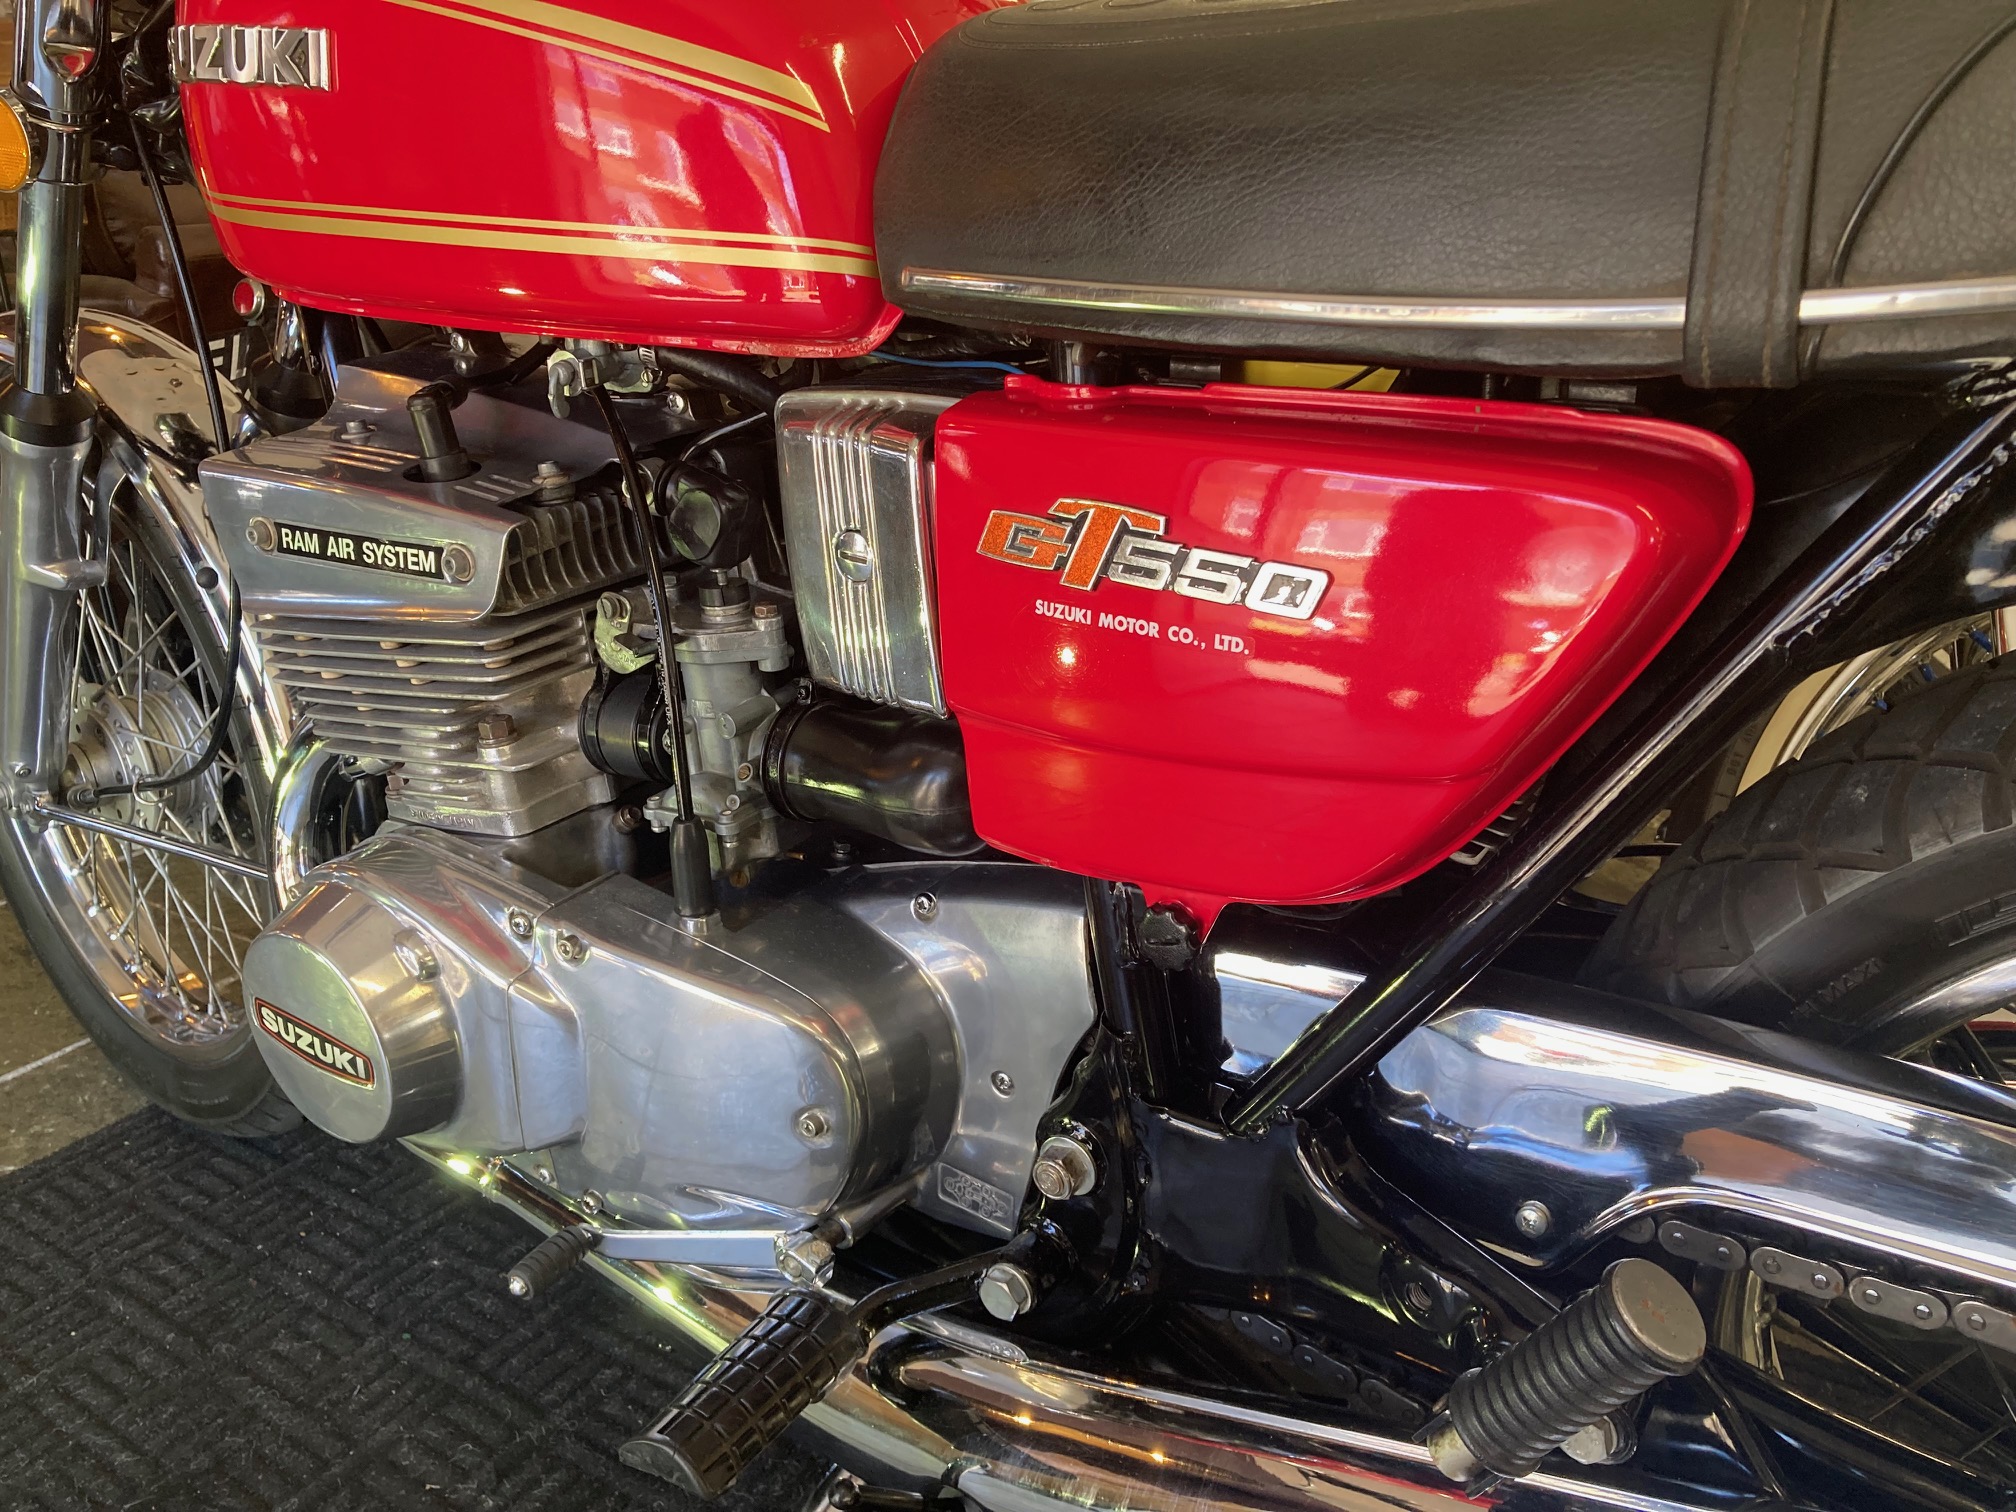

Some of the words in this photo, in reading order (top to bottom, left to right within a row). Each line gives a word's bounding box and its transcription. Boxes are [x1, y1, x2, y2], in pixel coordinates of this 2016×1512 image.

[169, 24, 332, 91] UZUKI
[281, 527, 320, 555] RAM
[326, 536, 356, 561] AIR
[362, 541, 436, 573] SYSTEM
[976, 497, 1334, 620] GT550
[1034, 599, 1092, 625] SUZUKI
[1098, 612, 1160, 638] MOTOR
[1167, 625, 1207, 651] CO.,
[1213, 633, 1250, 655] LTD.
[260, 1006, 367, 1080] SUZUKI
